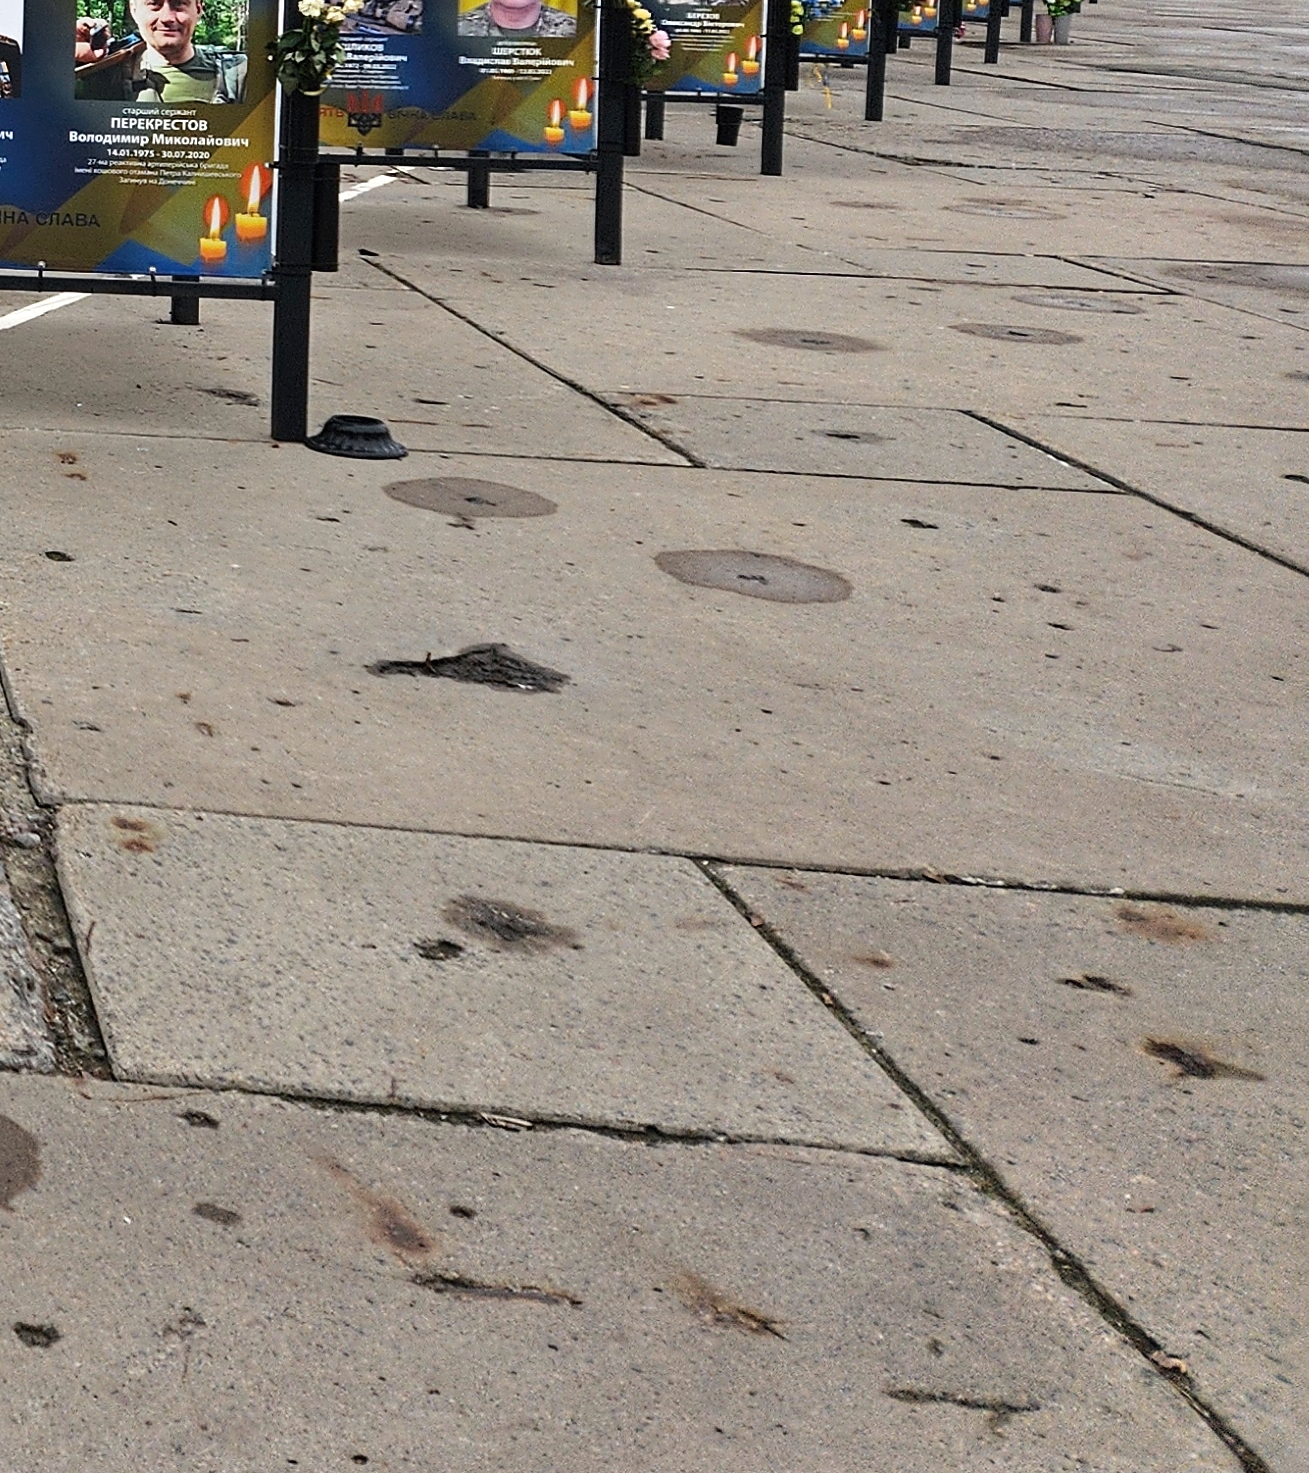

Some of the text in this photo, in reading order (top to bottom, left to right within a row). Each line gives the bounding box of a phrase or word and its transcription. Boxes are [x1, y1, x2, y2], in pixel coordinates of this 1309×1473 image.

[110, 117, 208, 131] ПЕРЕКРЕСТОВ
[69, 130, 249, 147] Володимир Миколайович
[35, 212, 101, 228] СЛАВА
